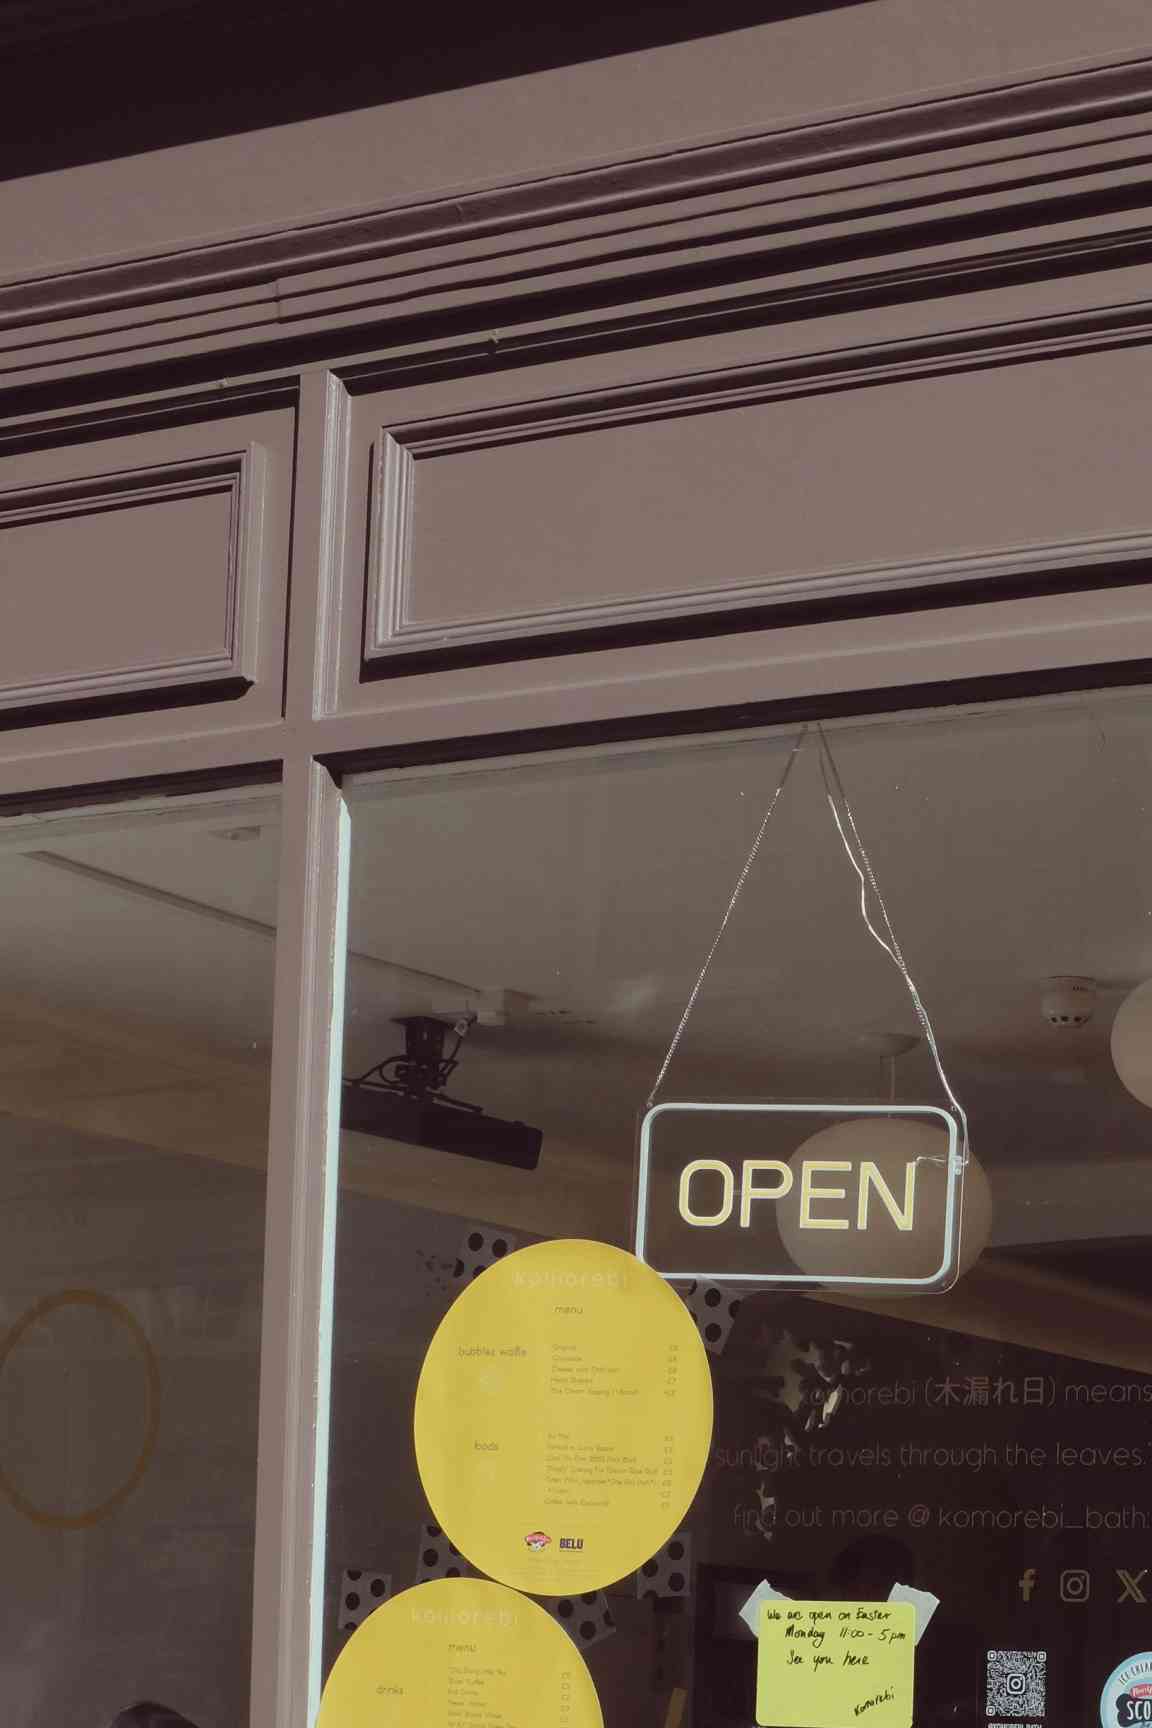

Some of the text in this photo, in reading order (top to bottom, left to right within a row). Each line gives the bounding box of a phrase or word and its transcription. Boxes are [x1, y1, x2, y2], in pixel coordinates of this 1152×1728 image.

[678, 1159, 917, 1231] OPEN
[1065, 1383, 1152, 1402] means
[808, 1442, 893, 1466] travels
[900, 1441, 997, 1473] through
[1005, 1442, 1048, 1466] the
[785, 1504, 825, 1528] out
[831, 1508, 899, 1528] more
[785, 1623, 827, 1648] Monday
